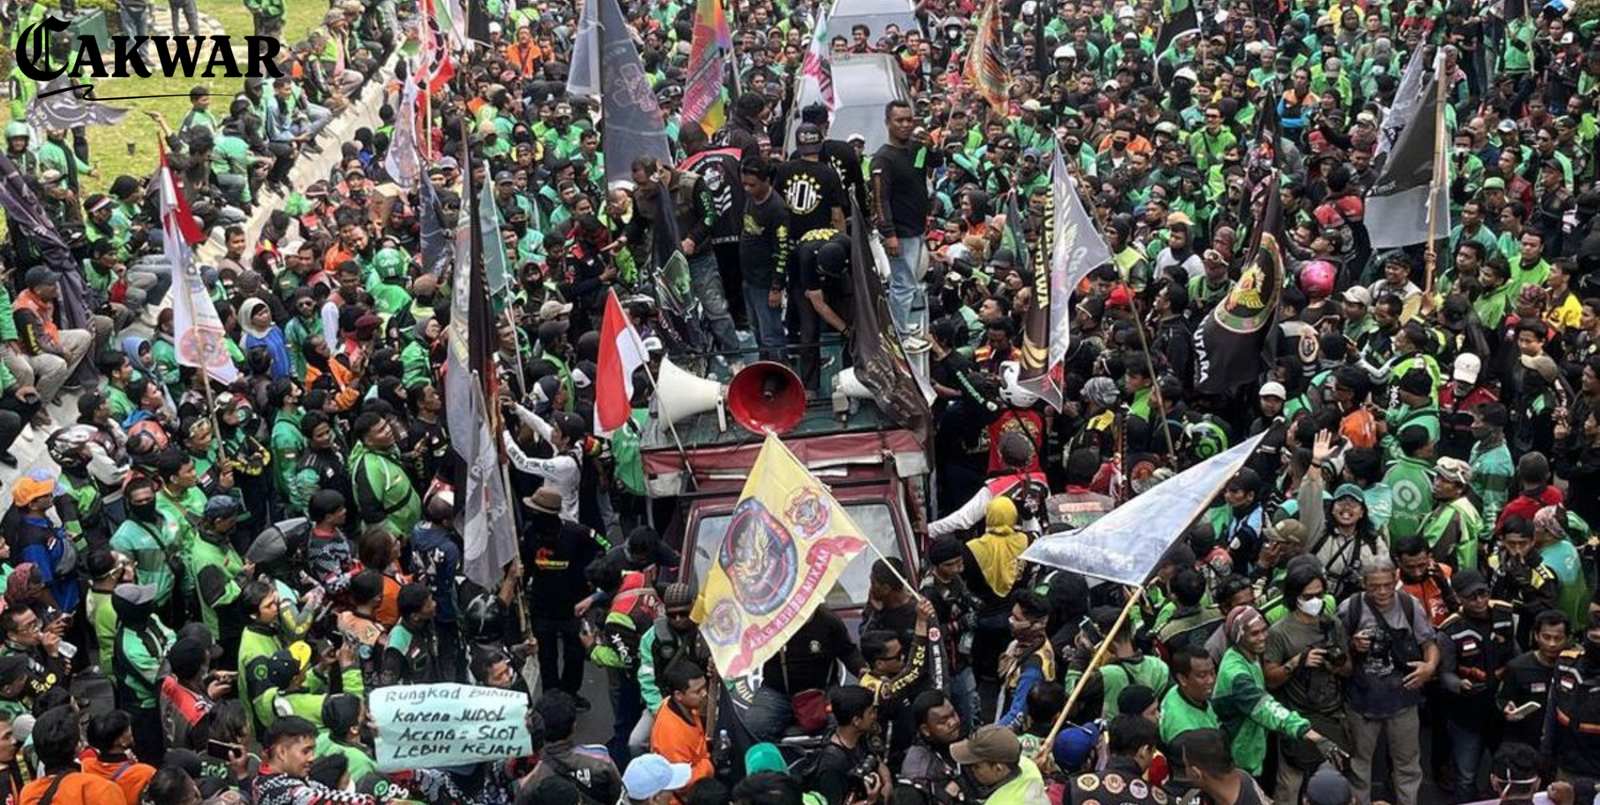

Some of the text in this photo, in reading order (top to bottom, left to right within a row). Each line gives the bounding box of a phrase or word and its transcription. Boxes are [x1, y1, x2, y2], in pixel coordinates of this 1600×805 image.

[1193, 328, 1211, 384] UTARA
[478, 725, 519, 741] SLOT
[393, 743, 451, 759] LEBIH
